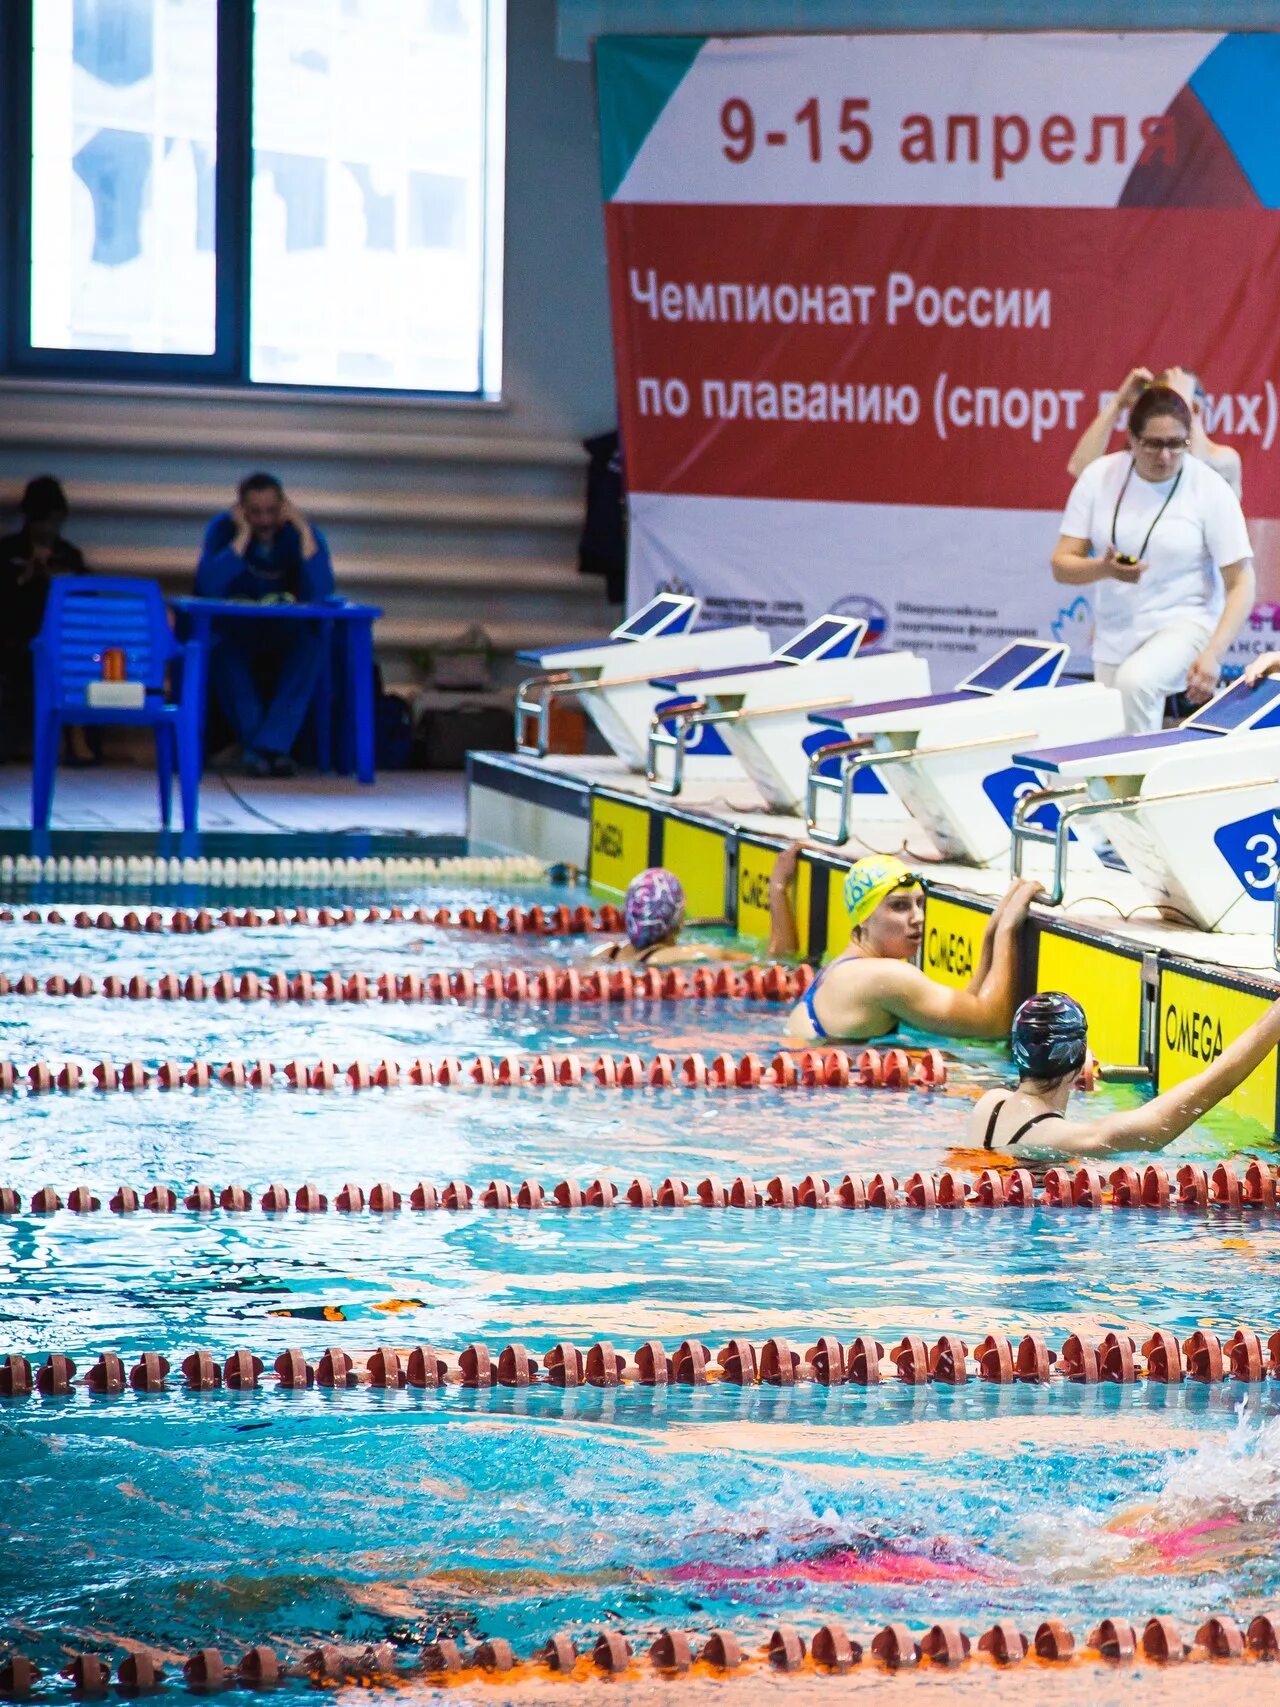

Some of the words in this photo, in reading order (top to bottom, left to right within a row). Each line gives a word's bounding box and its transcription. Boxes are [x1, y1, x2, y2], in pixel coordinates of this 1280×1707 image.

[719, 96, 873, 164] 9-15
[900, 112, 1178, 181] апреля
[629, 268, 875, 324] Чемпионат
[886, 272, 1052, 329] России
[637, 377, 690, 417] по
[702, 378, 919, 425] плаванию
[932, 372, 1084, 442] (спорт
[1243, 833, 1280, 889] 3
[927, 927, 973, 977] OMEGA
[1165, 1004, 1224, 1064] OMEGA
